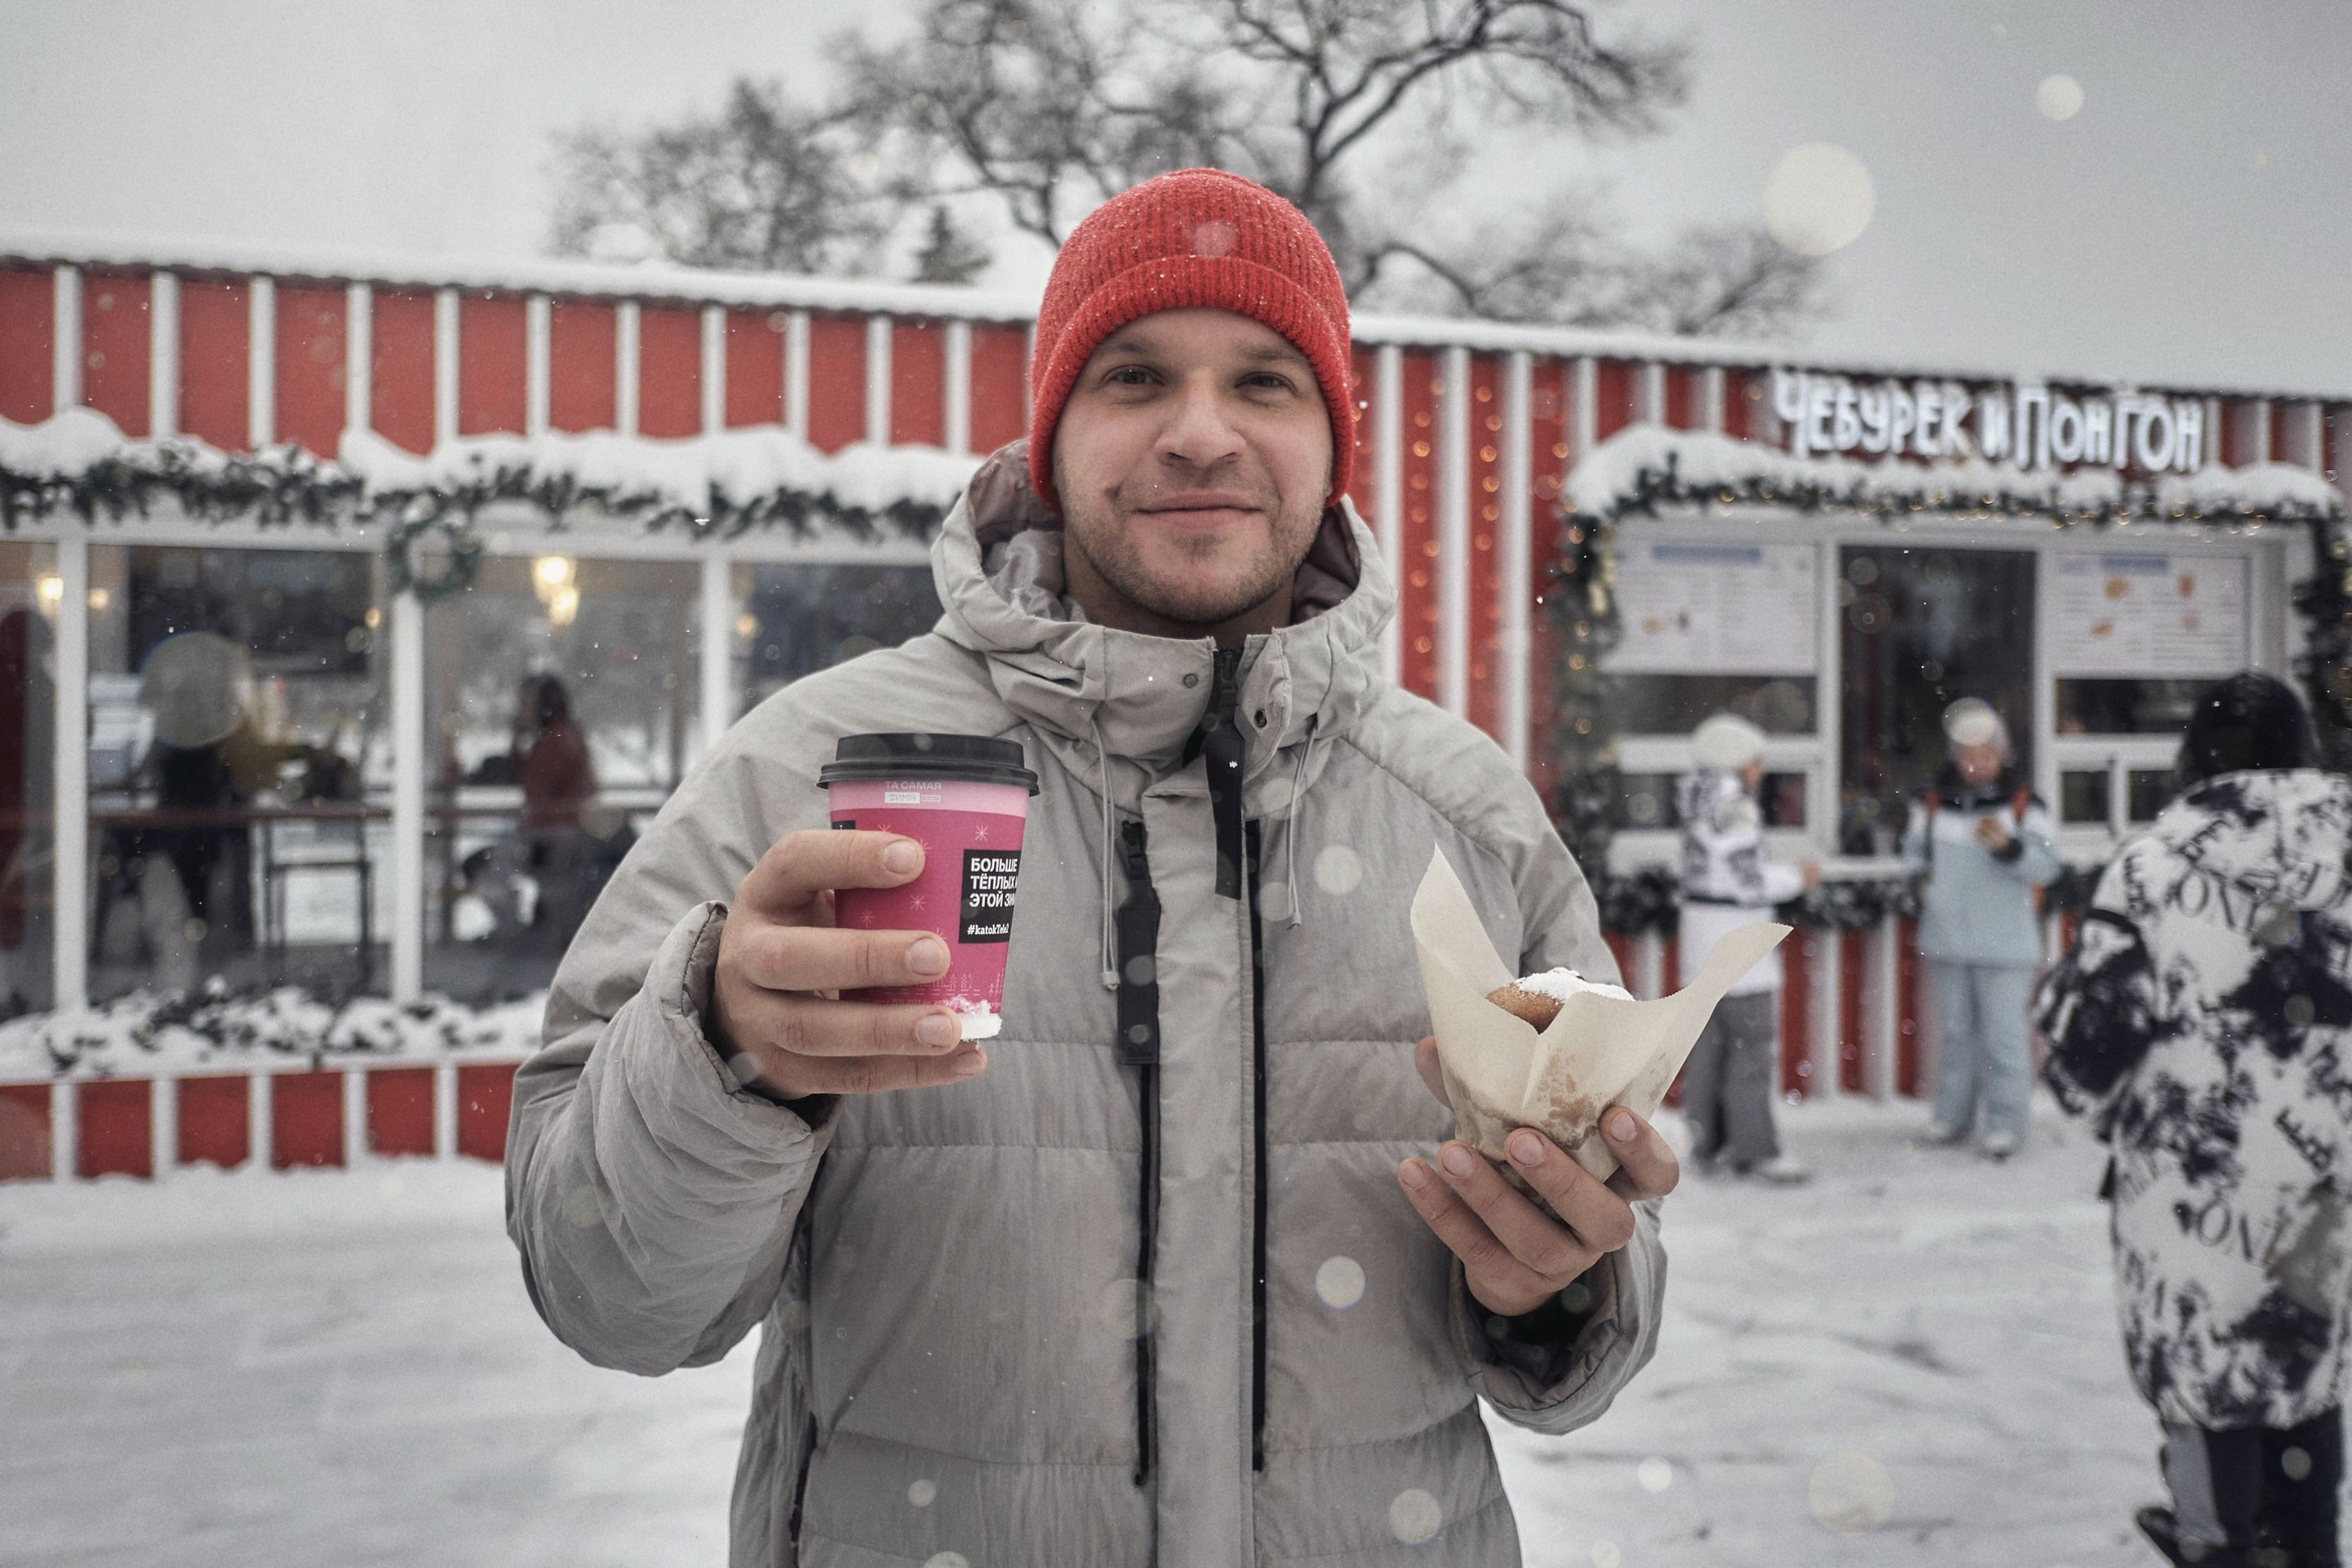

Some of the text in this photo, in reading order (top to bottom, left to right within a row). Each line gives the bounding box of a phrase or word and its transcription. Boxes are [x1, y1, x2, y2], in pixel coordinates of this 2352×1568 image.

[1774, 371, 1973, 458] ЧЕБУРЕК
[901, 780, 941, 790] САМАЯ
[970, 857, 1018, 873] БОЛЬШЕ
[970, 873, 1015, 890] ТЁПЛЫХ
[969, 890, 1003, 908] ЭТОЙ
